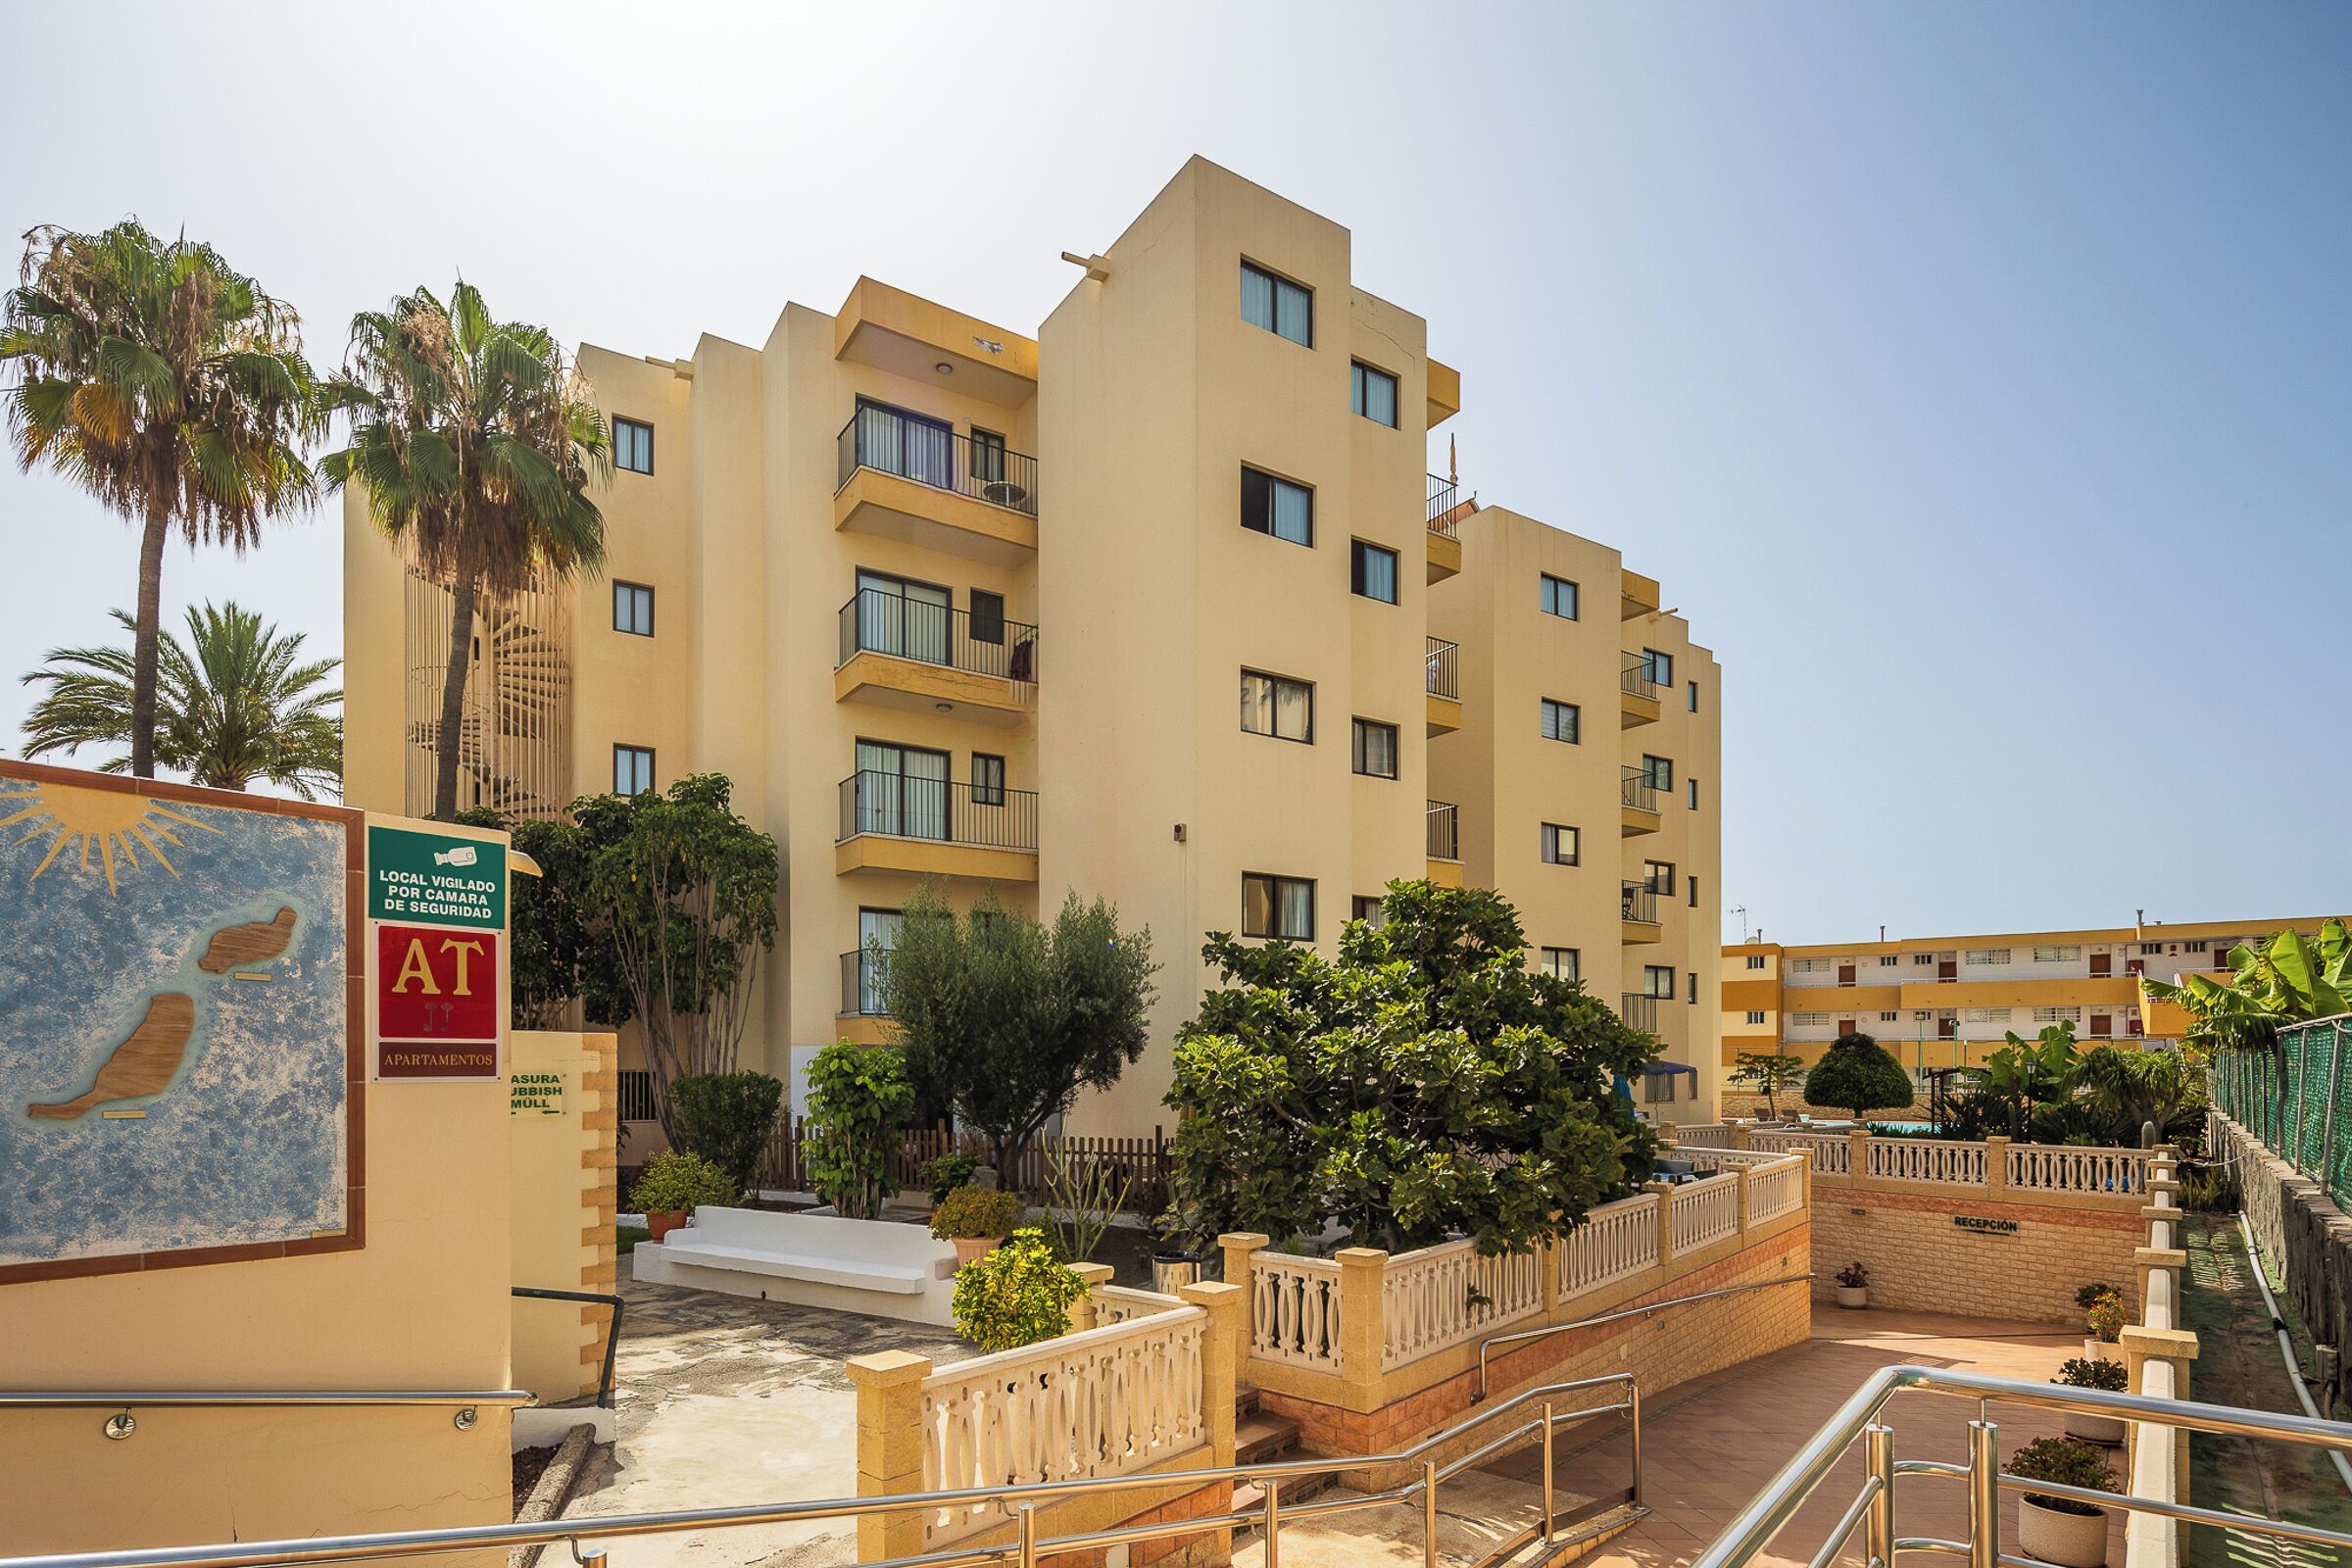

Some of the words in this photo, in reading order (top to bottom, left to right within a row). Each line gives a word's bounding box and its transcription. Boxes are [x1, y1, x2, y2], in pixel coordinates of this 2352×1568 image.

[379, 869, 428, 886] LOCAL
[431, 875, 496, 893] VIGILADO
[388, 885, 420, 899] POR
[425, 888, 488, 906] CAMARA
[384, 899, 405, 911] DE
[410, 901, 492, 919] SEGURIDAD
[392, 938, 484, 996] AT
[384, 1054, 493, 1065] APARTAMENTOS
[511, 1097, 550, 1109] MÜLL
[1954, 1216, 2018, 1232] RECEPCIÓN
